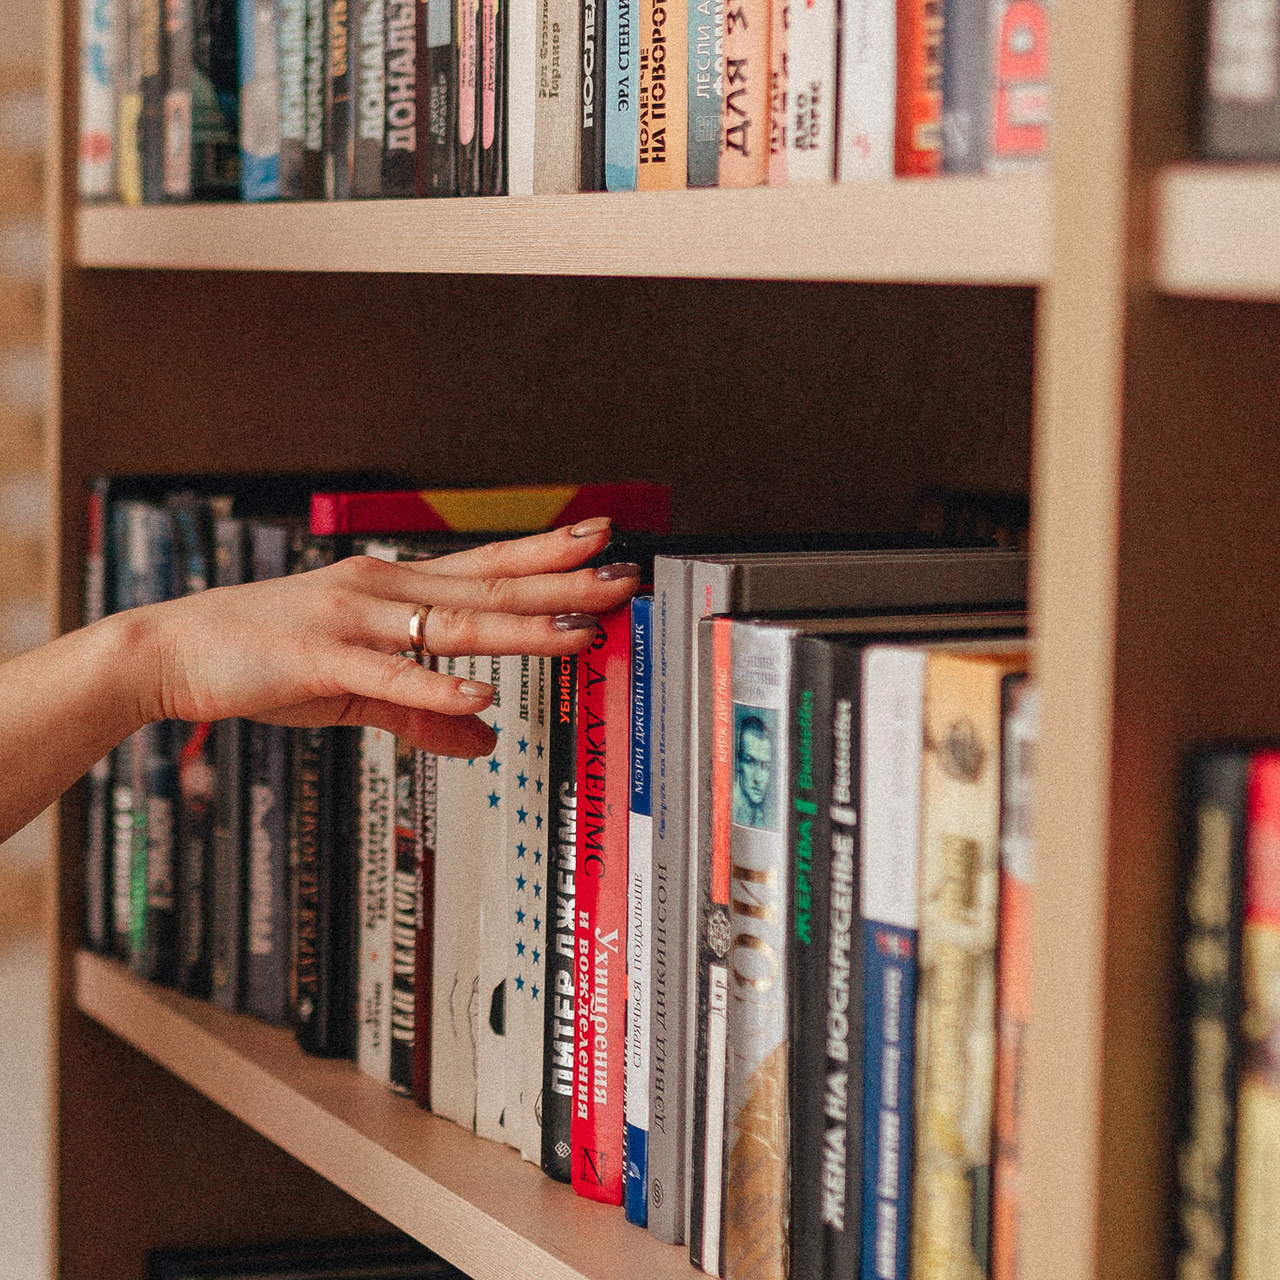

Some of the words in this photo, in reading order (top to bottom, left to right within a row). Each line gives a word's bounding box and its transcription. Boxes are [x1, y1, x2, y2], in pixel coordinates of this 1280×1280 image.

[618, 77, 630, 112] ЭРЛ
[695, 25, 711, 99] ЛЕСЛИ
[726, 57, 751, 158] ДЛЯ
[652, 127, 666, 163] НА
[519, 655, 529, 721] ДЕТЕКТИВ
[558, 656, 570, 725] УБИЙСТ
[635, 623, 644, 676] КЛАРК
[717, 666, 729, 723] ДУГЛАС
[634, 681, 645, 745] ДЖЕЙН
[717, 727, 728, 763] КИРК
[424, 751, 437, 852] МАНЕКЕН
[584, 705, 612, 879] ДЖЕЙМС
[635, 747, 645, 795] МЭРИ
[550, 781, 578, 960] ДЖЕЙМС
[794, 821, 812, 944] ЖЕРТВА
[579, 910, 590, 929] и
[633, 872, 644, 971] ПОДАЛЬШЕ
[655, 862, 668, 1030] ДИКИНСОН
[825, 833, 854, 1063] ВОСКРЕСЕНЬЕ
[551, 969, 575, 1097] ПИТЕР
[578, 937, 590, 1121] вожделения
[590, 927, 619, 1105] Ухищрения
[632, 980, 643, 1068] СПРЯЧЬСЯ
[655, 1036, 667, 1134] ДЭВИД
[824, 1071, 848, 1121] НА
[821, 1126, 847, 1230] ЖЕНА
